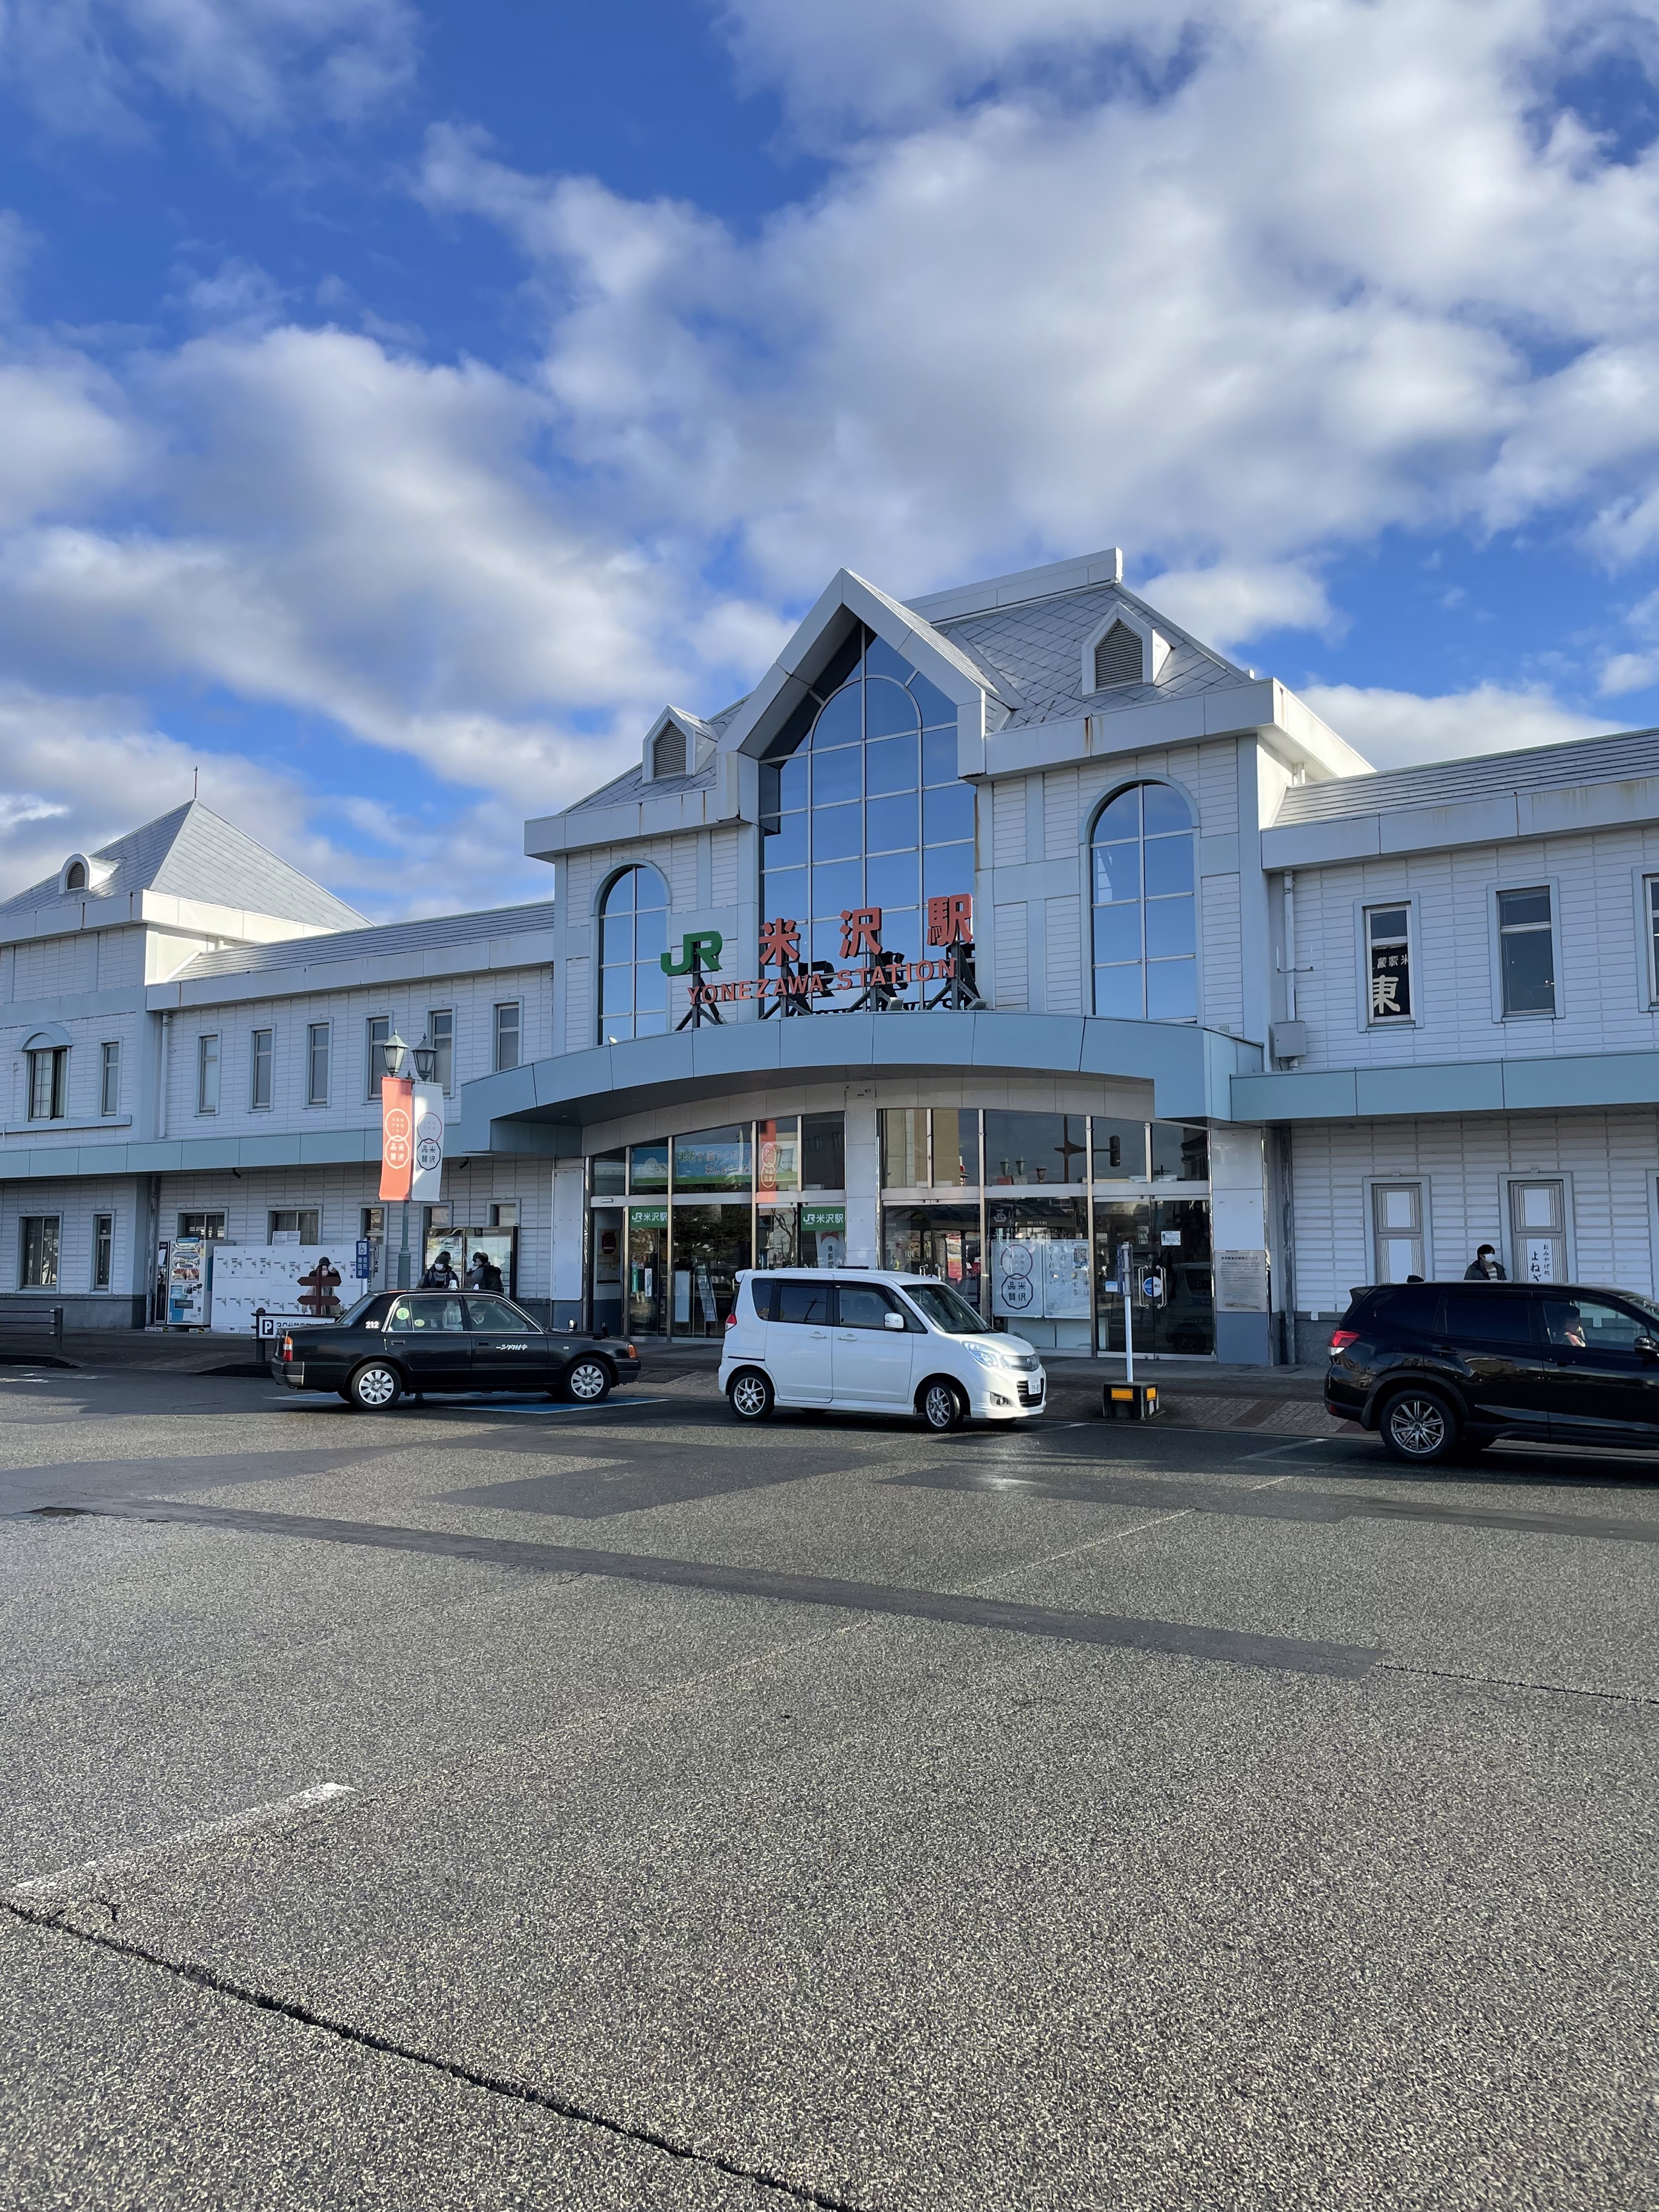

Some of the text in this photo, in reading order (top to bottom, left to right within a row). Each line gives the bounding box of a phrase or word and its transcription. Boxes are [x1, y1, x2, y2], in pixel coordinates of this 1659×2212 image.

[660, 893, 973, 976] JR 米沢駅
[687, 957, 956, 1006] YONEZAWA STATION
[631, 1212, 668, 1222] JR 米沢駅
[803, 1214, 844, 1223] JR 米沢駅
[1017, 1281, 1026, 1301] 米沢
[365, 1321, 379, 1329] 212
